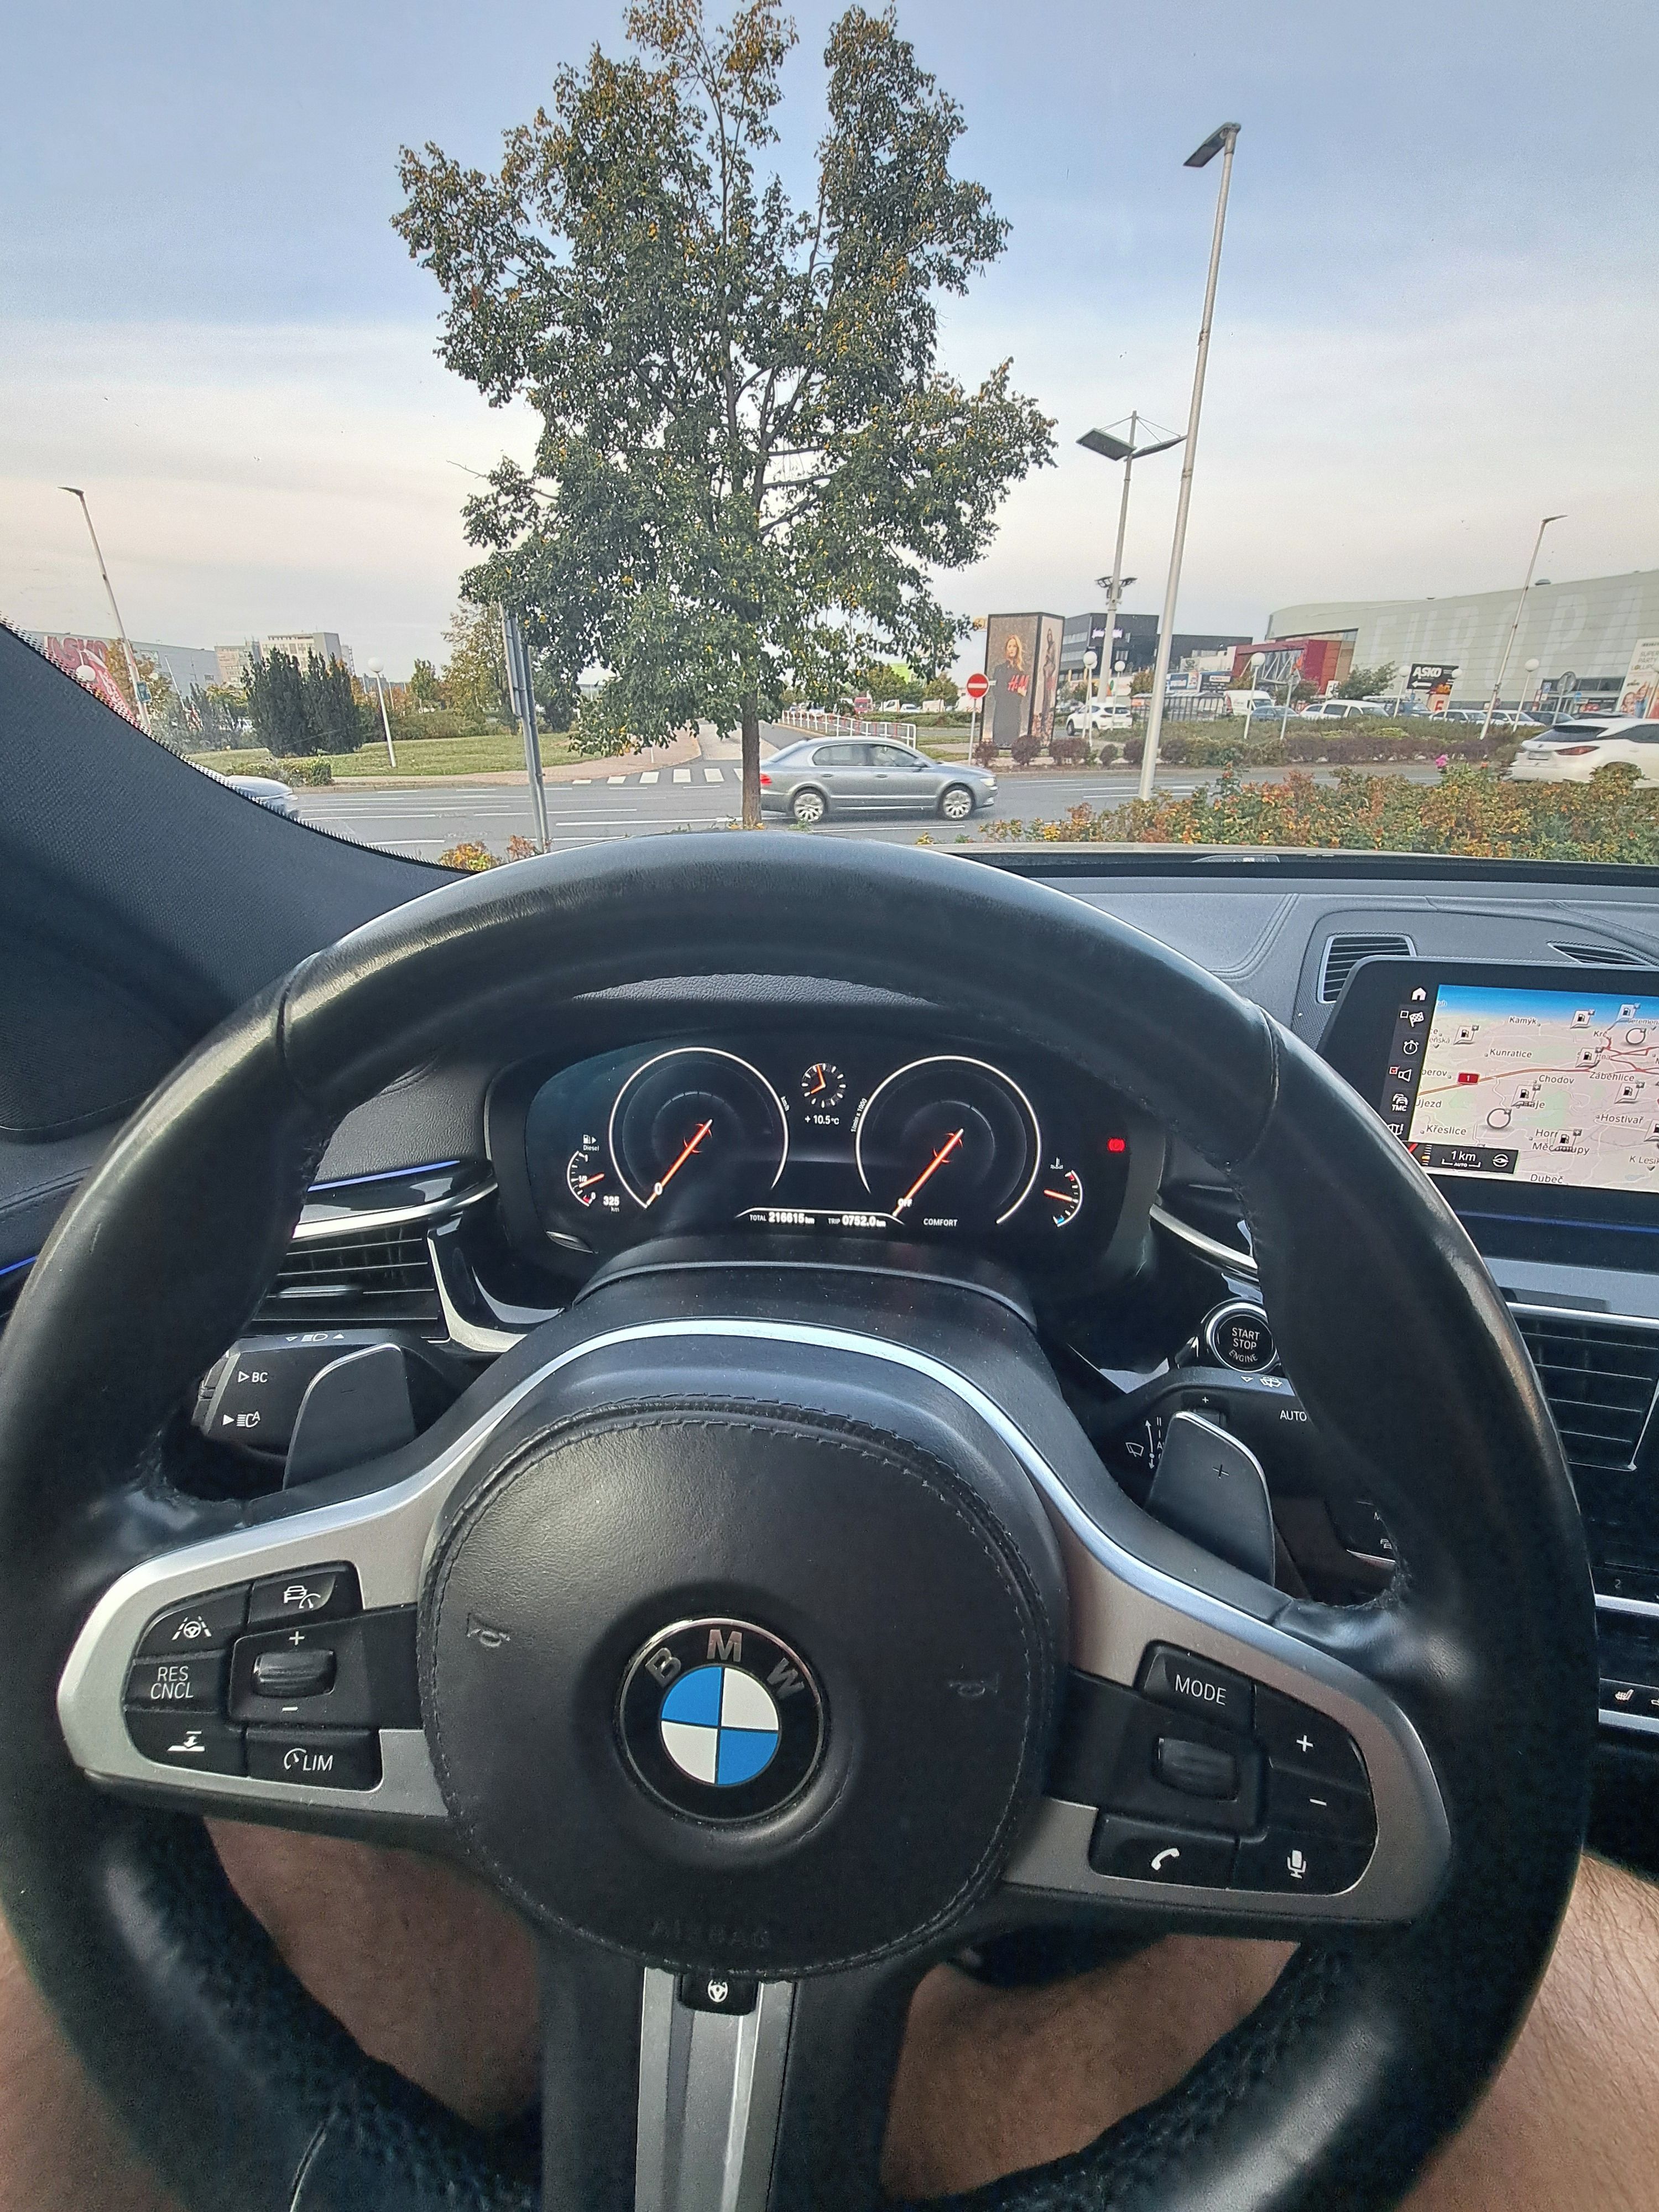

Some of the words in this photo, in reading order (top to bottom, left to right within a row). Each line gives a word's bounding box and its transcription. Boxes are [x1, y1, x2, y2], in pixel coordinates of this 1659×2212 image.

[1412, 666, 1442, 679] ASKO
[1008, 675, 1029, 692] H&M
[1509, 1016, 1537, 1025] Kamýk
[1490, 1048, 1532, 1058] Kunratice
[1539, 1074, 1575, 1084] Chodov
[1590, 1072, 1635, 1082] Záběhlice
[1600, 1114, 1644, 1125] Hostivař
[1426, 1124, 1467, 1135] Křeslice
[1451, 1151, 1457, 1160] 1
[1459, 1151, 1476, 1161] km
[1530, 1173, 1563, 1184] Dubeč
[654, 1183, 663, 1196] 0
[603, 1196, 620, 1206] 325
[898, 1198, 913, 1207] OFF
[749, 1214, 766, 1222] TOTAL
[842, 1215, 876, 1227] 0752.0
[923, 1218, 958, 1227] COMFORT
[1232, 1327, 1260, 1340] START
[1233, 1338, 1257, 1350] STOP
[1229, 1349, 1258, 1363] ENGINE
[252, 1371, 268, 1383] BC
[1280, 1409, 1307, 1422] AUTO
[645, 1629, 805, 1700] BMW
[156, 1665, 189, 1682] RES
[150, 1682, 194, 1700] CNCL
[1175, 1674, 1227, 1706] MODE
[302, 1754, 333, 1772] LIM
